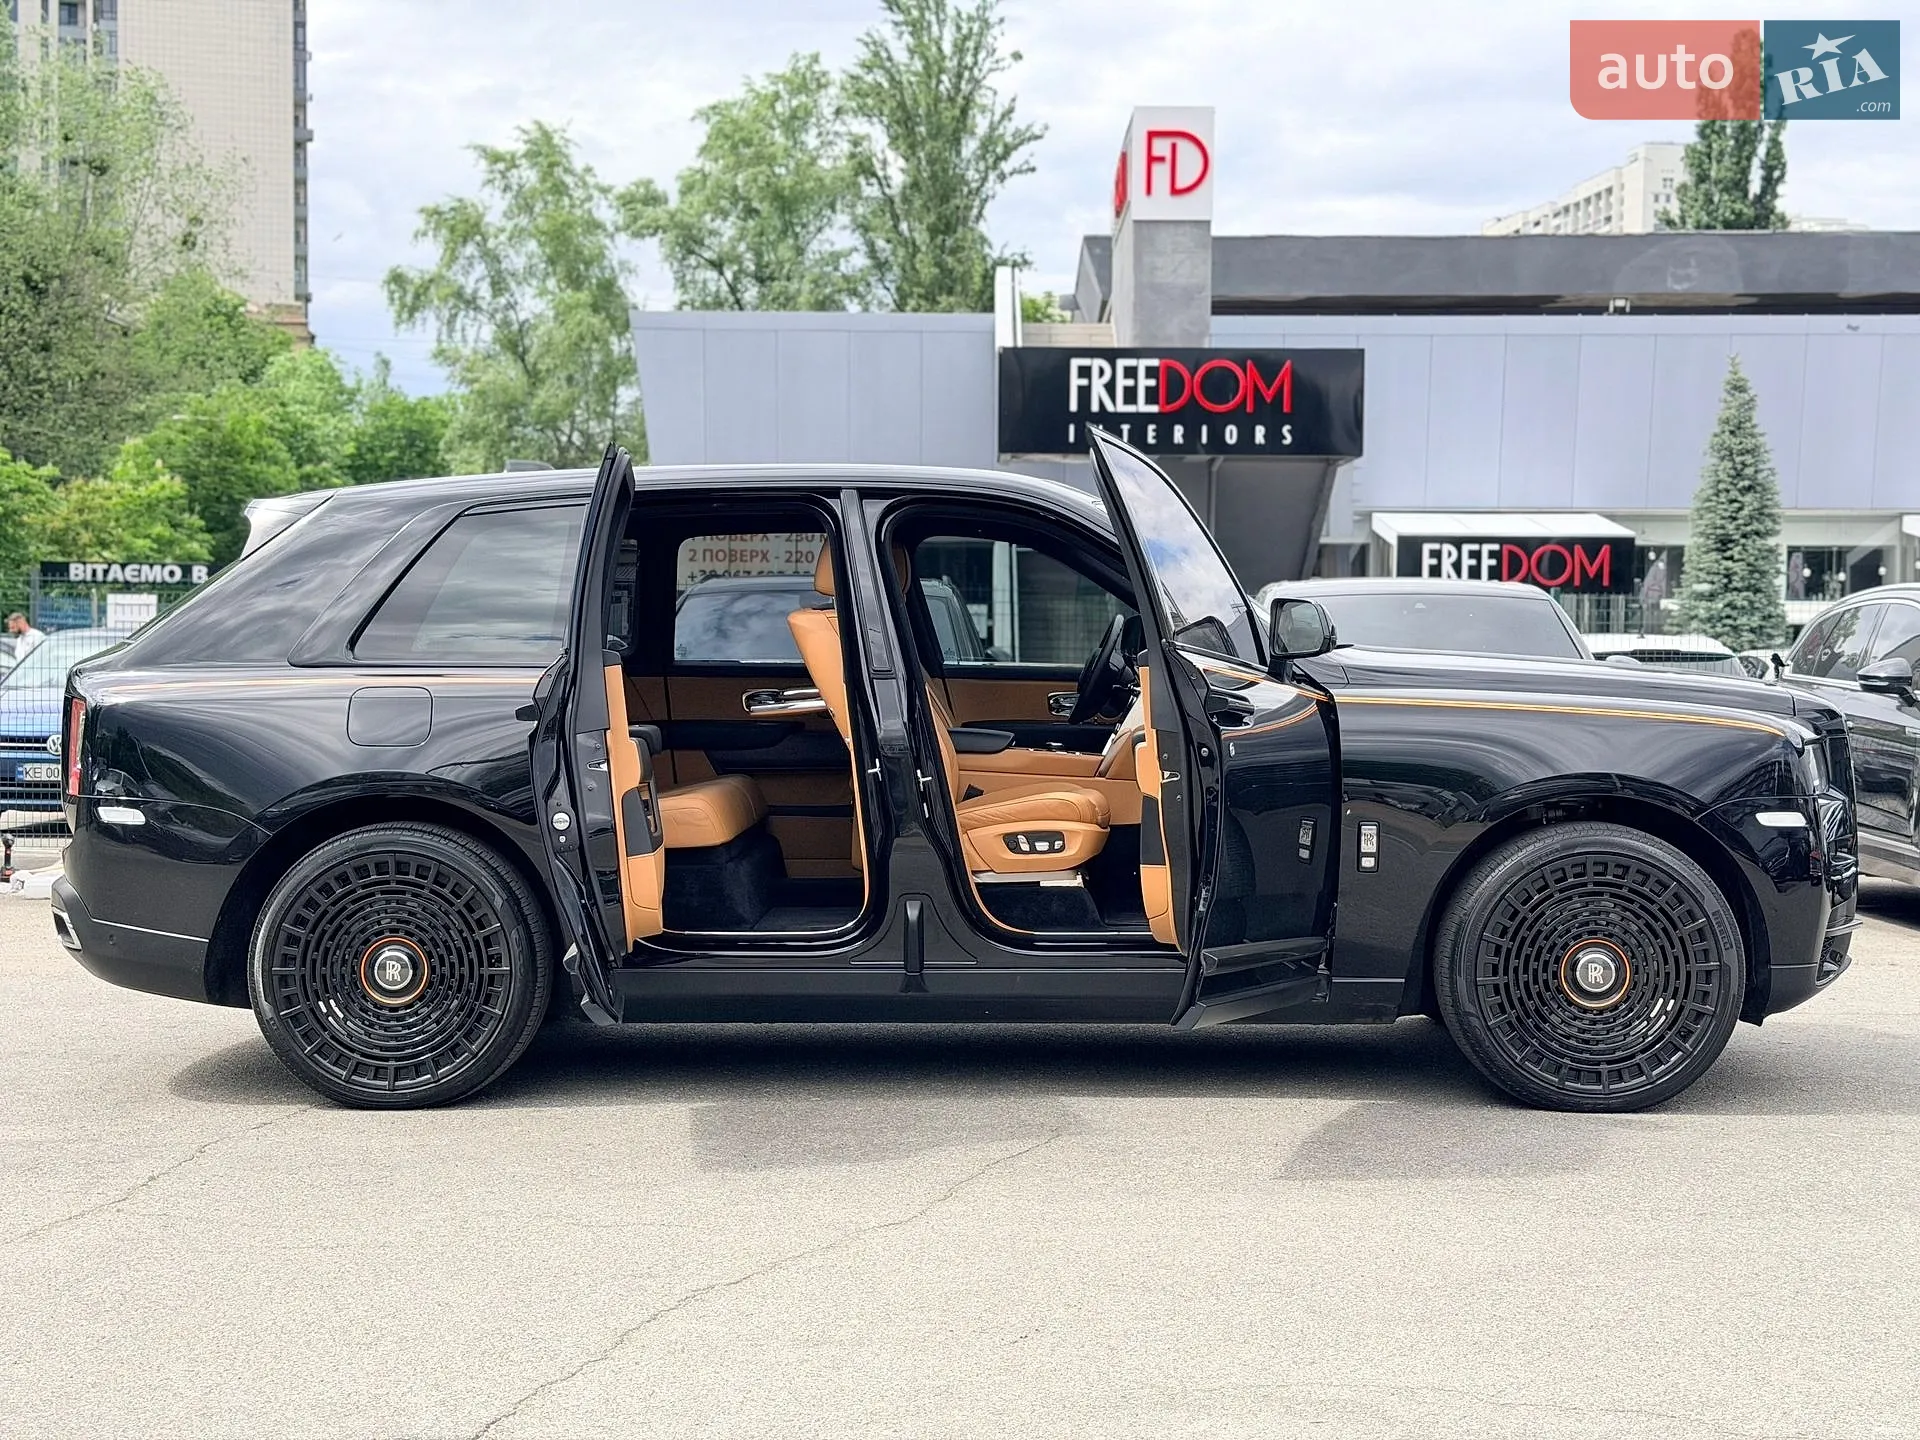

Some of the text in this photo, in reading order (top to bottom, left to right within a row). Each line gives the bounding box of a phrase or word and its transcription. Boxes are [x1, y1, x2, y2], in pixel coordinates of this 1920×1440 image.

[1146, 130, 1210, 197] FD
[1069, 358, 1293, 414] FREEDOM
[1068, 424, 1293, 445] ITERIORS
[688, 549, 697, 562] 2
[703, 548, 770, 563] ПОВЕРХ
[784, 550, 815, 563] 220
[1421, 542, 1611, 587] FREEDOM
[69, 563, 182, 583] ВІТАЄМО
[386, 960, 401, 981] RR
[1588, 963, 1604, 984] RR
